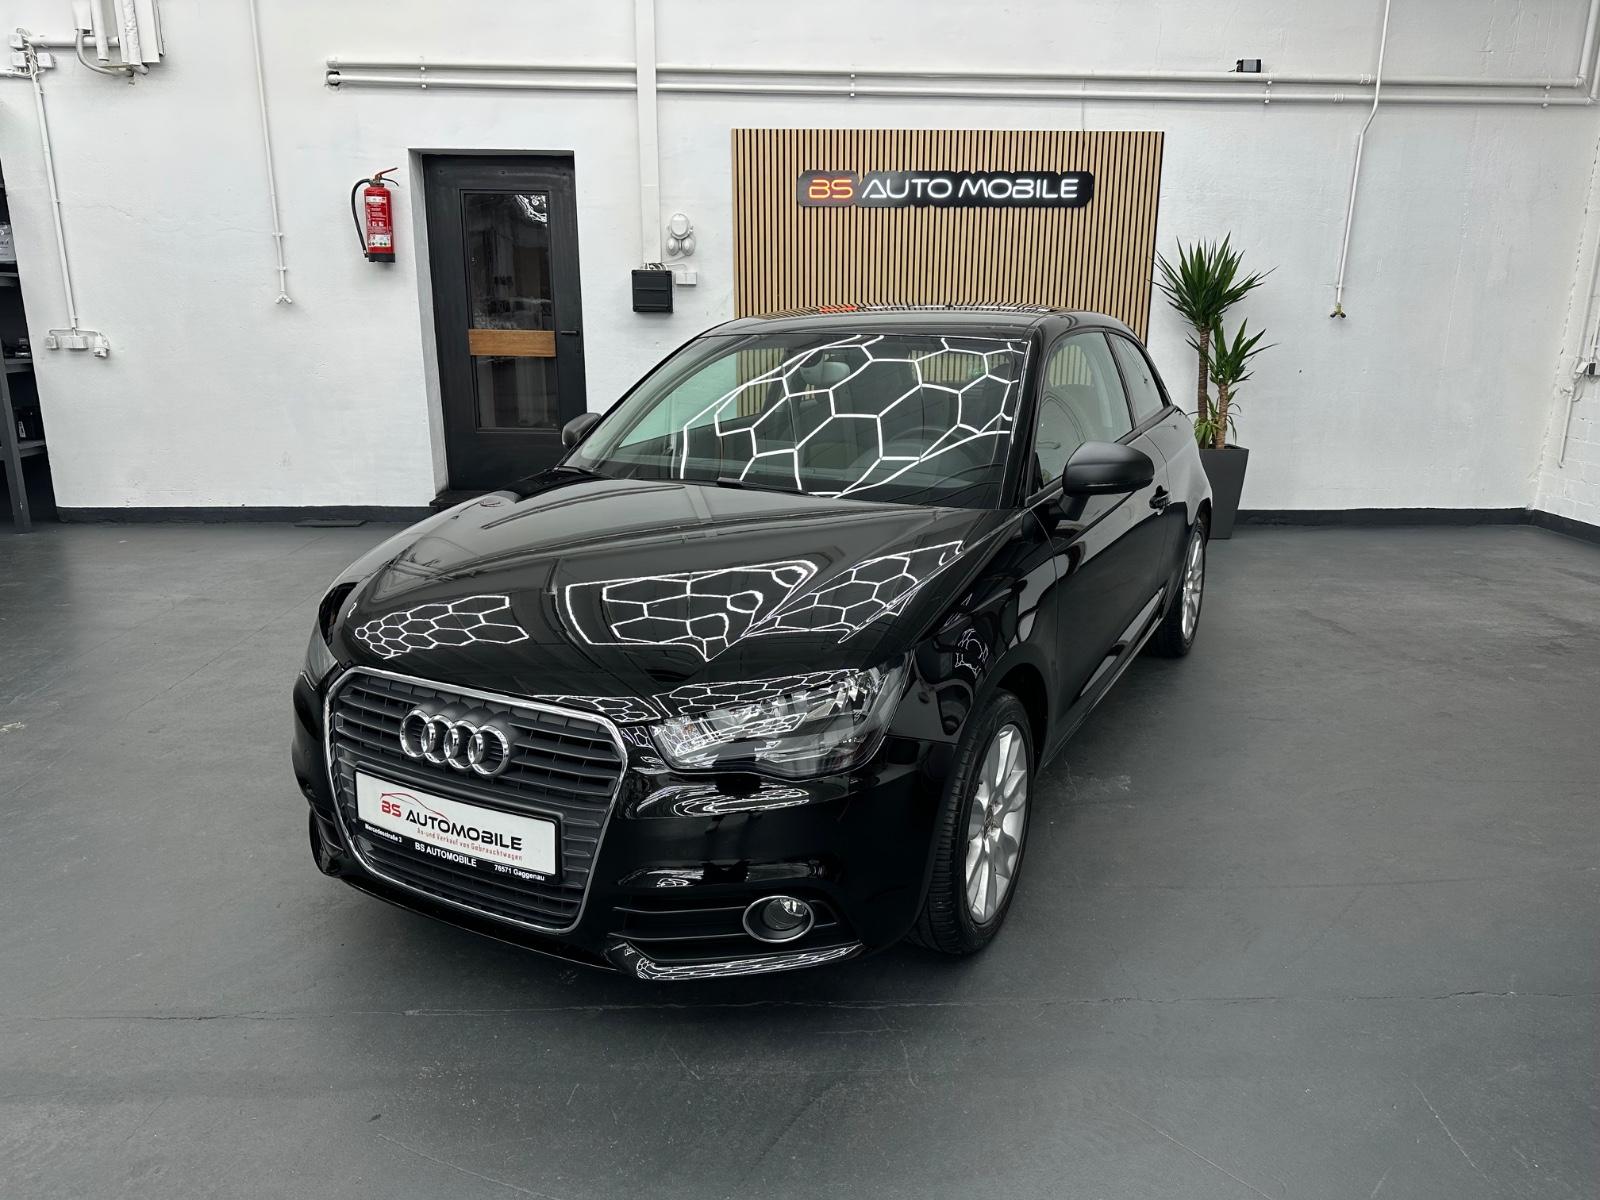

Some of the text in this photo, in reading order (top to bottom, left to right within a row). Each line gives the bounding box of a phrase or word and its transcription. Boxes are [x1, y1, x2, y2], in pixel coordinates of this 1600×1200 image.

[808, 178, 1080, 199] BS AUTO MOBILE
[381, 800, 523, 851] BS AUTOMOBILE
[415, 842, 477, 867] BS AUTOMOBILE
[494, 864, 545, 881] 76571 Gaggenau
